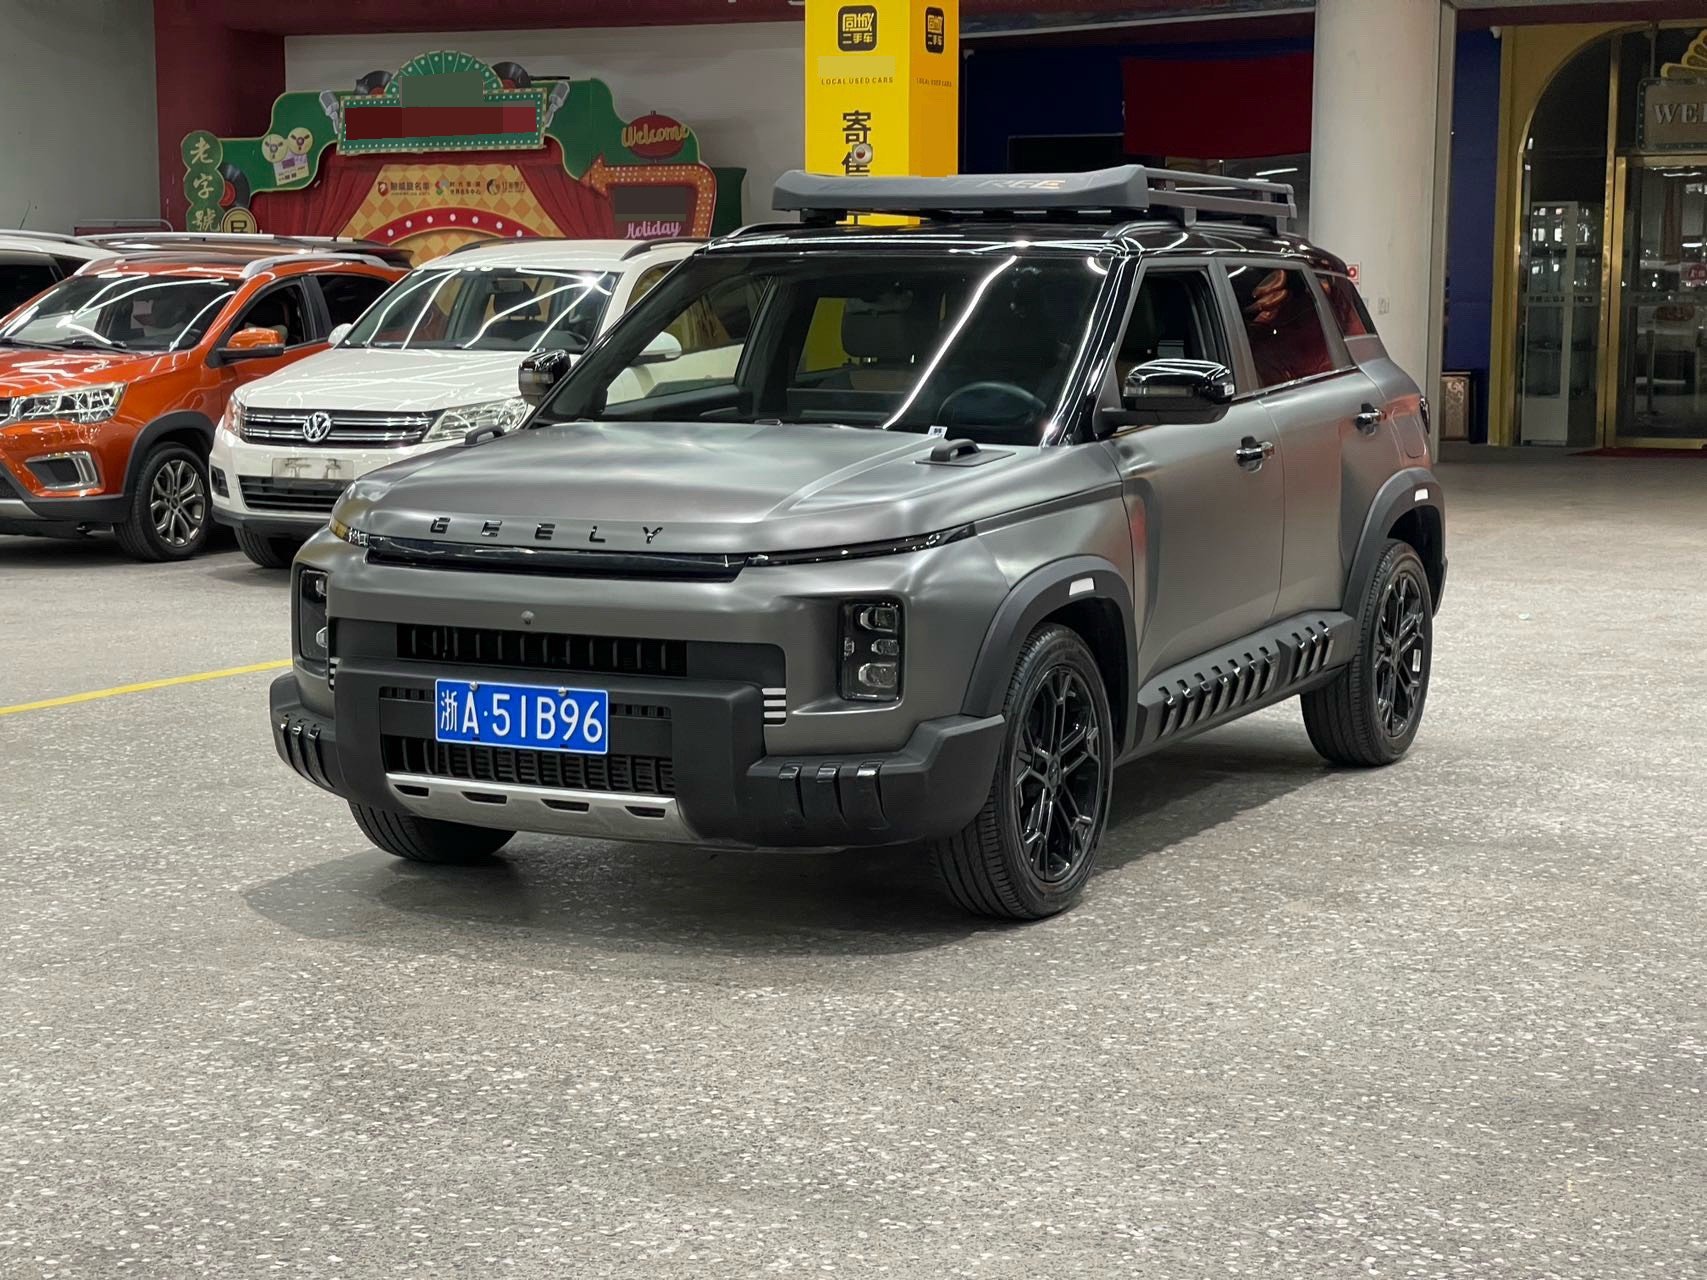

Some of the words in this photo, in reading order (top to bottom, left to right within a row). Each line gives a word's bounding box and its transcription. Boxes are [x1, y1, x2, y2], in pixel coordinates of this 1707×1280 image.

[842, 33, 873, 44] 二手车
[871, 76, 894, 84] CARS
[621, 123, 690, 148] Welcome
[625, 220, 682, 239] Holiday
[430, 517, 664, 544] GEELY
